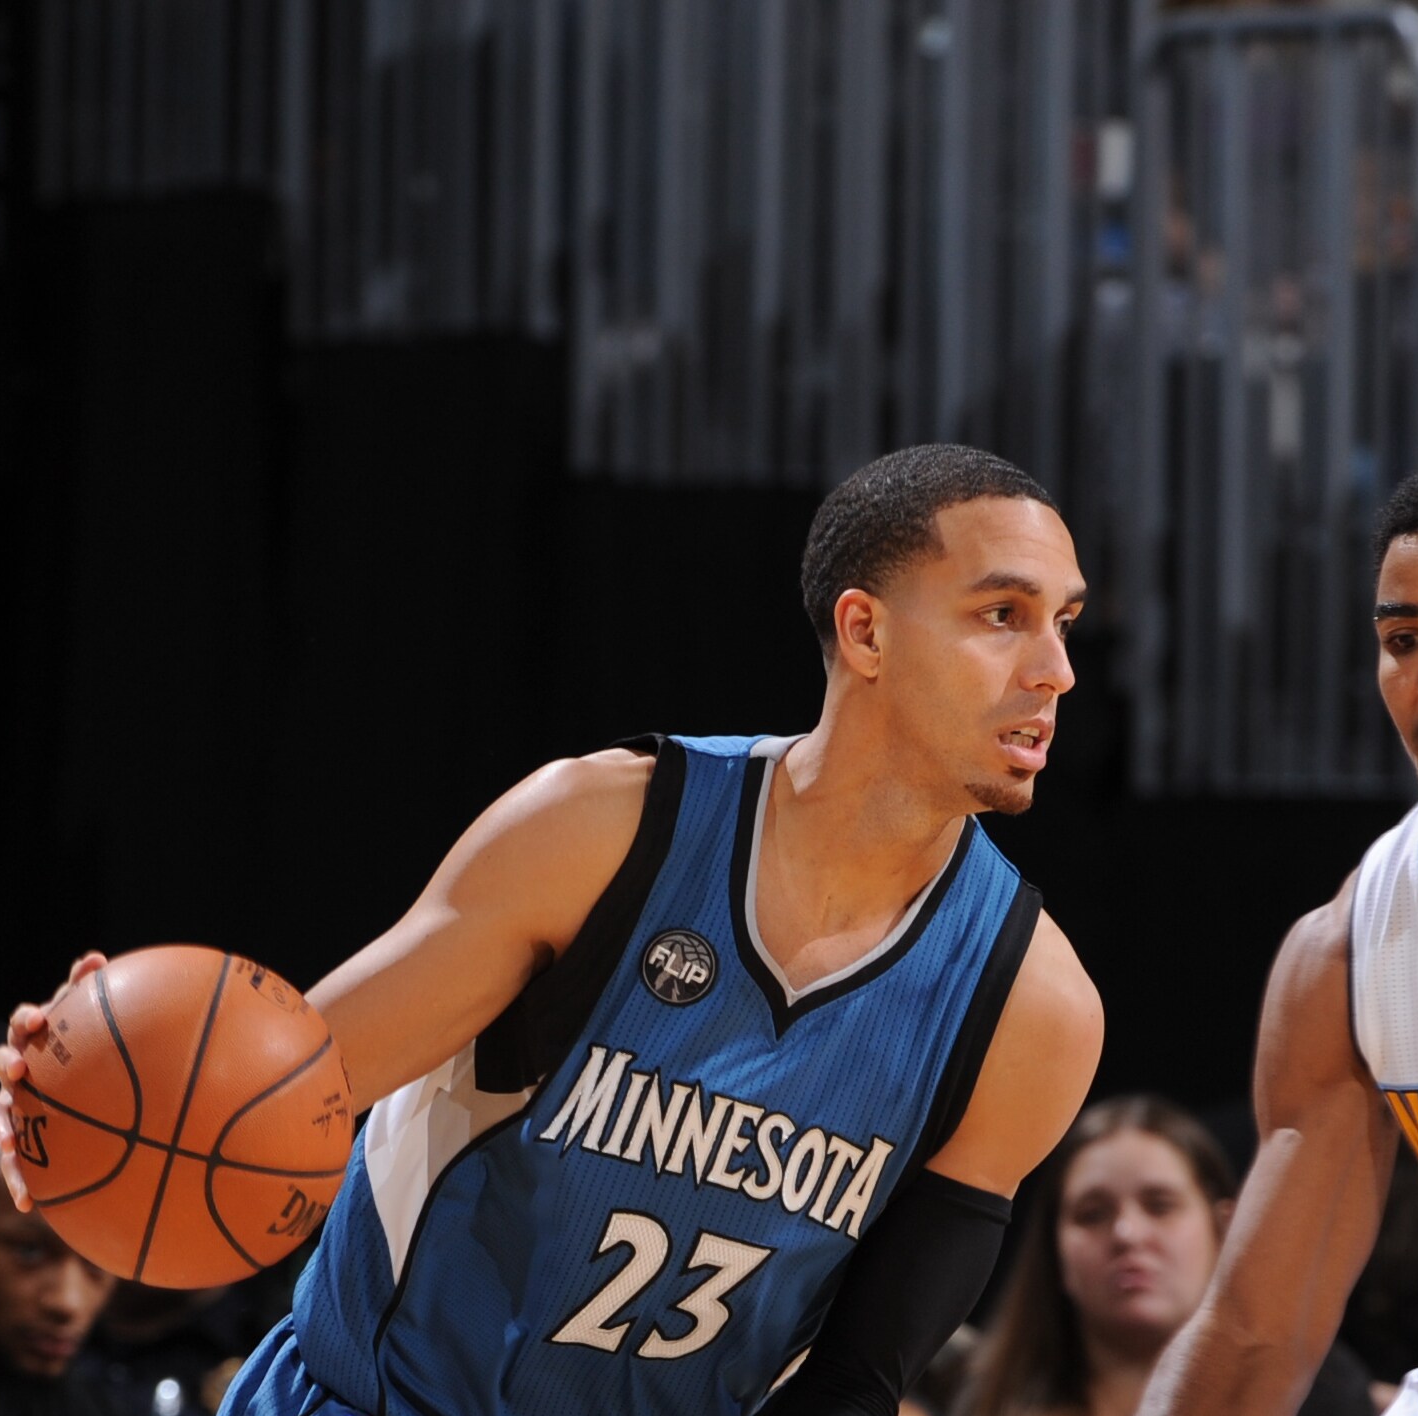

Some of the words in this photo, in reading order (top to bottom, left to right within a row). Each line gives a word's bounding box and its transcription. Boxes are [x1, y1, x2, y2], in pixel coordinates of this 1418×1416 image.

[648, 944, 710, 986] FLIP
[537, 1045, 895, 1241] MINNESOTA
[545, 1210, 777, 1361] 23
